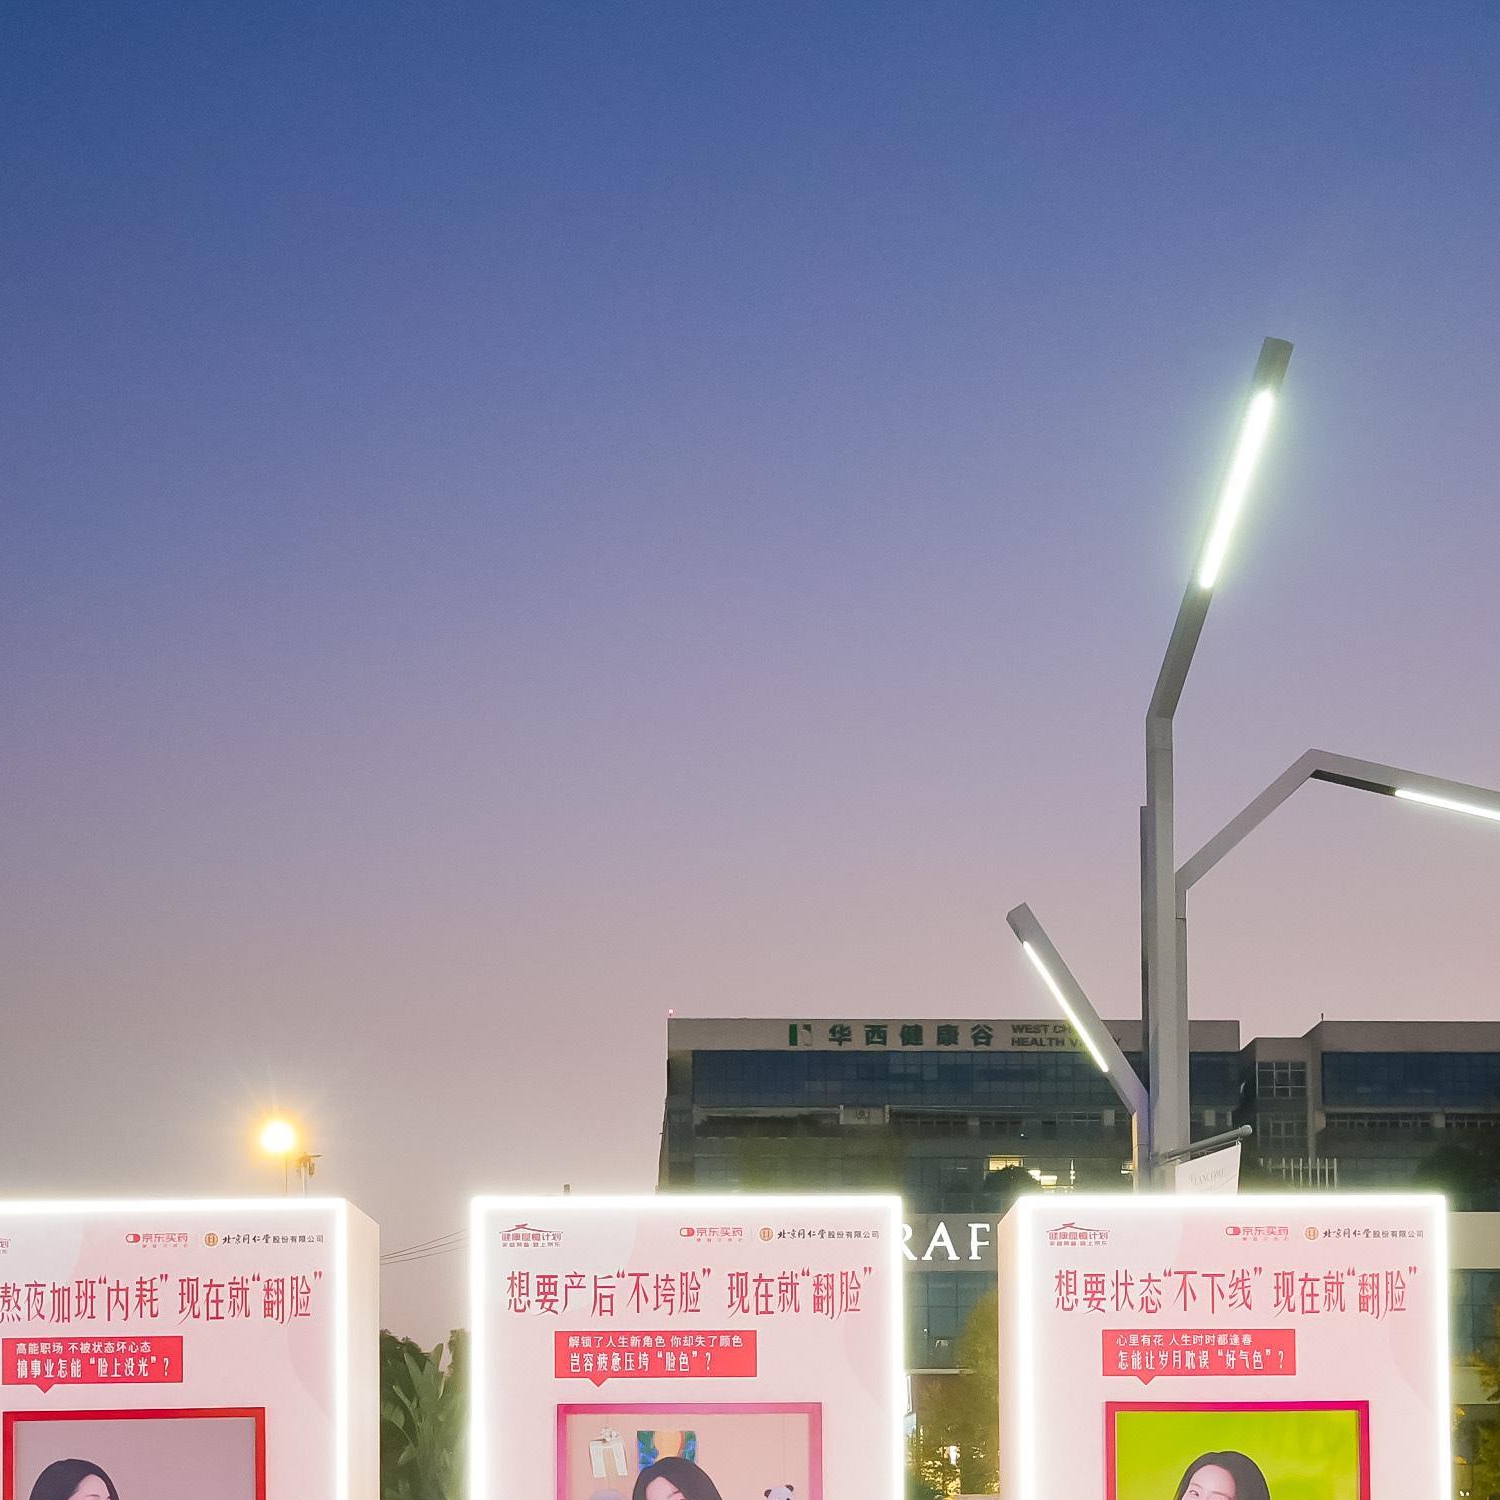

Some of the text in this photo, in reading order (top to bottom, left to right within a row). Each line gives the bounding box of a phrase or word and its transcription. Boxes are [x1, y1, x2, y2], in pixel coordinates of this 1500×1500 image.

[1011, 1023, 1050, 1034] WEST
[828, 1023, 995, 1047] 华西健康谷
[1011, 1037, 1064, 1047] HEALTH
[696, 1227, 743, 1237] 京东买药
[776, 1228, 880, 1240] 北京同仁堂股份有限公司
[1242, 1226, 1289, 1236] 京东买药
[1322, 1227, 1424, 1239] 北京同仁堂股份有限公司
[142, 1233, 188, 1243] 京东买药
[221, 1233, 324, 1245] 北京同仁堂股份有限公司
[177, 1270, 323, 1326] 现在就“翻脸”
[505, 1266, 873, 1320] 想要产后“不垮脸” 现在就“翻脸”
[1053, 1266, 1418, 1321] 想要状态“不下线” 现在就“翻脸”
[568, 1334, 744, 1348] 解锁了人生新角色 你却失了颜色
[1115, 1333, 1164, 1346] 心里有花
[16, 1343, 64, 1355] 高能职场
